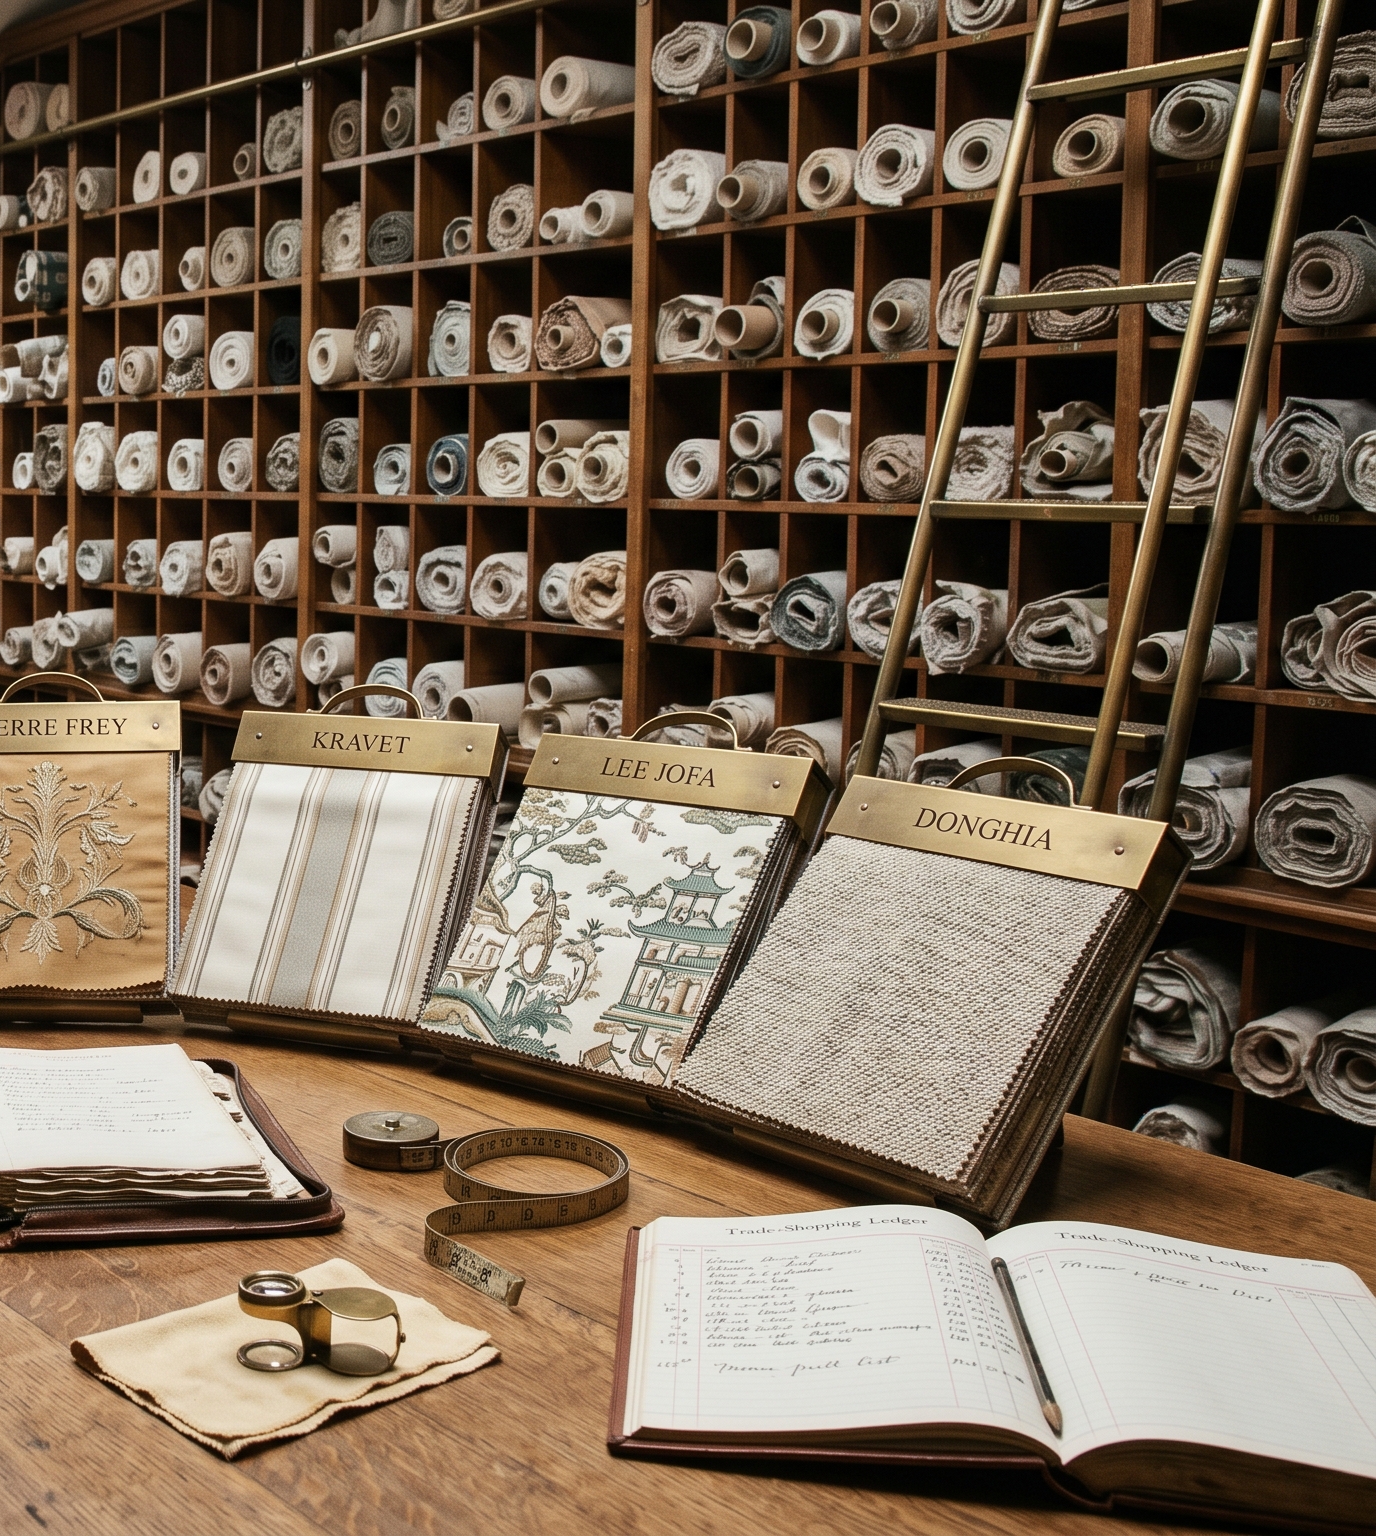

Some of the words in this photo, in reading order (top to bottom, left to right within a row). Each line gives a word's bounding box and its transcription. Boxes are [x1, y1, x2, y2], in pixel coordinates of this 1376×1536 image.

[66, 718, 128, 736] FREY
[311, 731, 411, 754] KRAVET
[600, 757, 650, 780] LEE
[654, 762, 716, 788] JOFA
[913, 806, 1053, 851] DONGHIA
[869, 1216, 929, 1225] Ledger
[1207, 1255, 1269, 1273] Ledger
